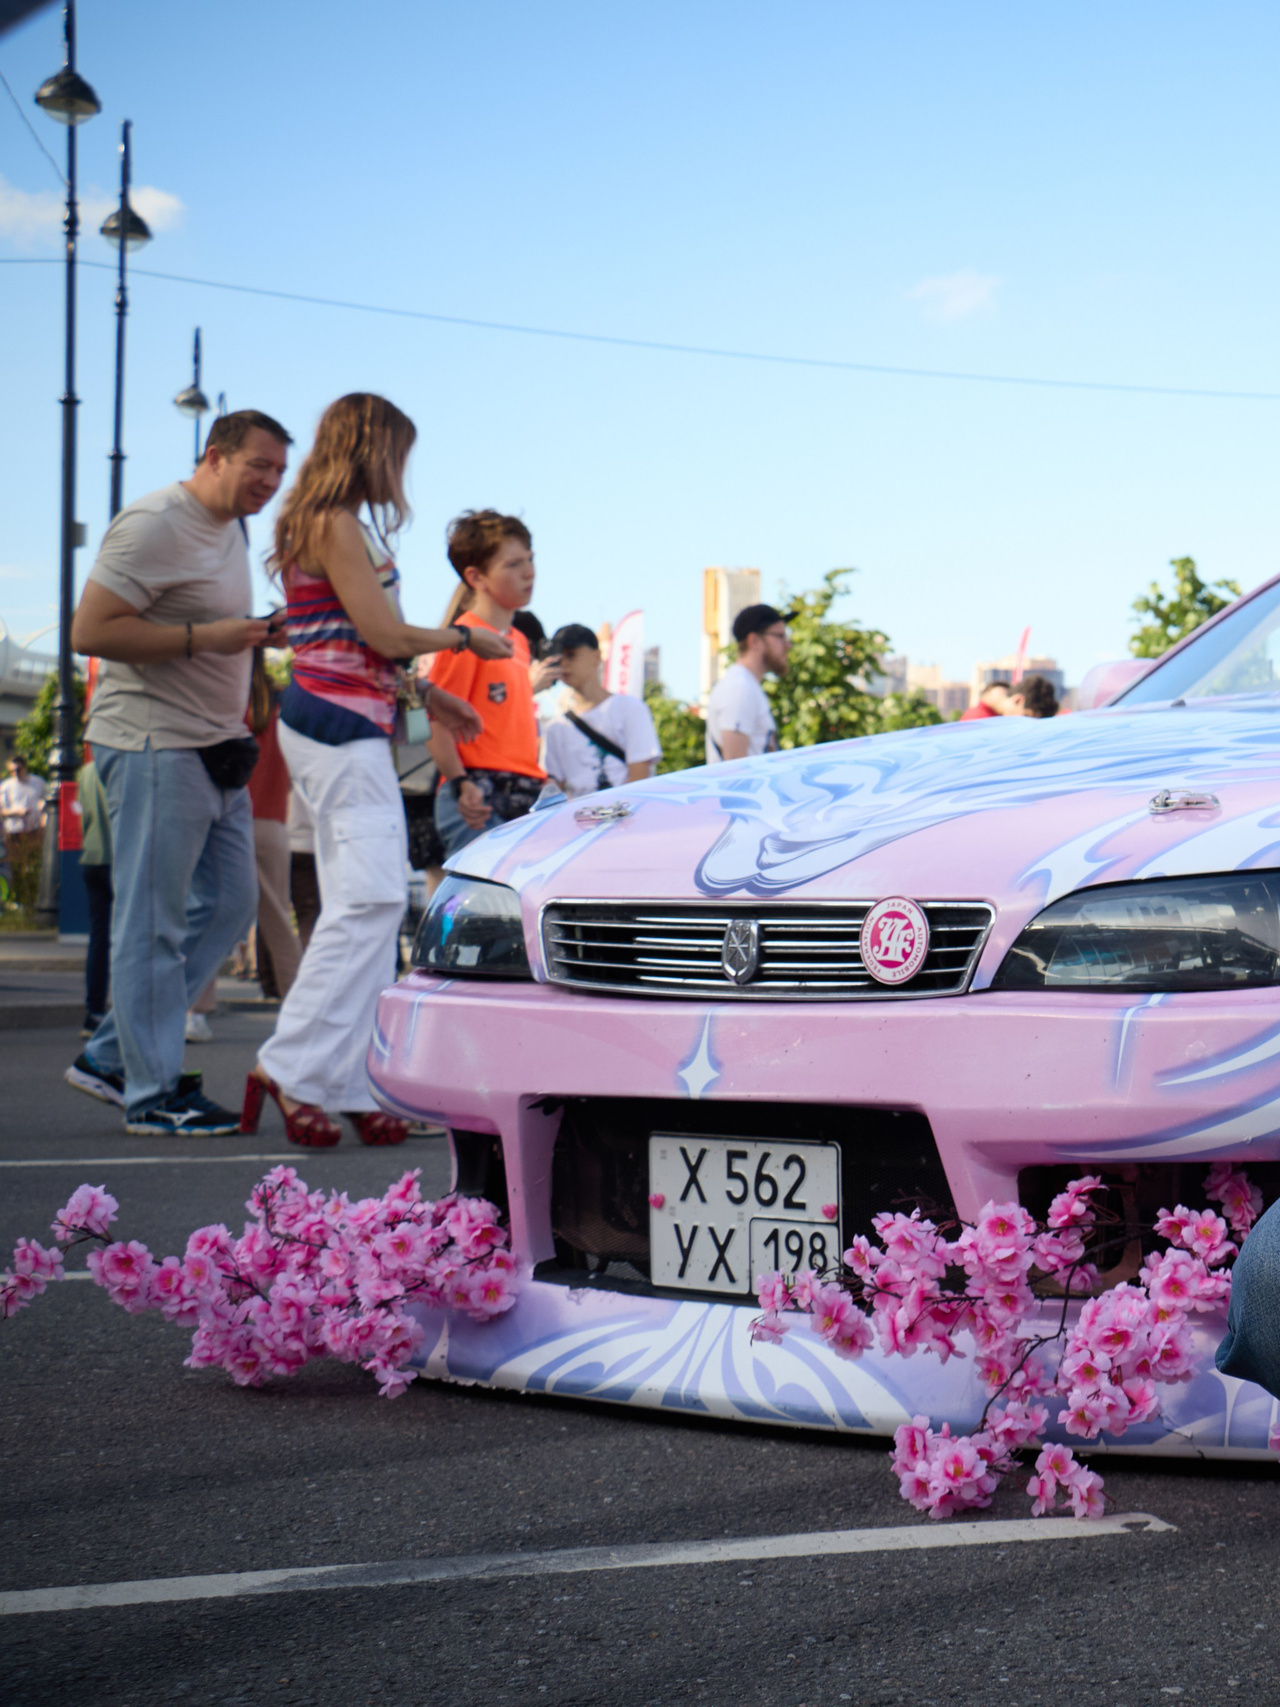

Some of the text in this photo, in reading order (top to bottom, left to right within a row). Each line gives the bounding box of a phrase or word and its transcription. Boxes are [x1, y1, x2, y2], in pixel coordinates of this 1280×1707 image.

[887, 902, 913, 914] JAPAN
[863, 916, 882, 974] FEDERATION
[892, 927, 923, 978] AUTOMOBILE
[725, 1149, 807, 1211] 562
[763, 1228, 828, 1274] 198
